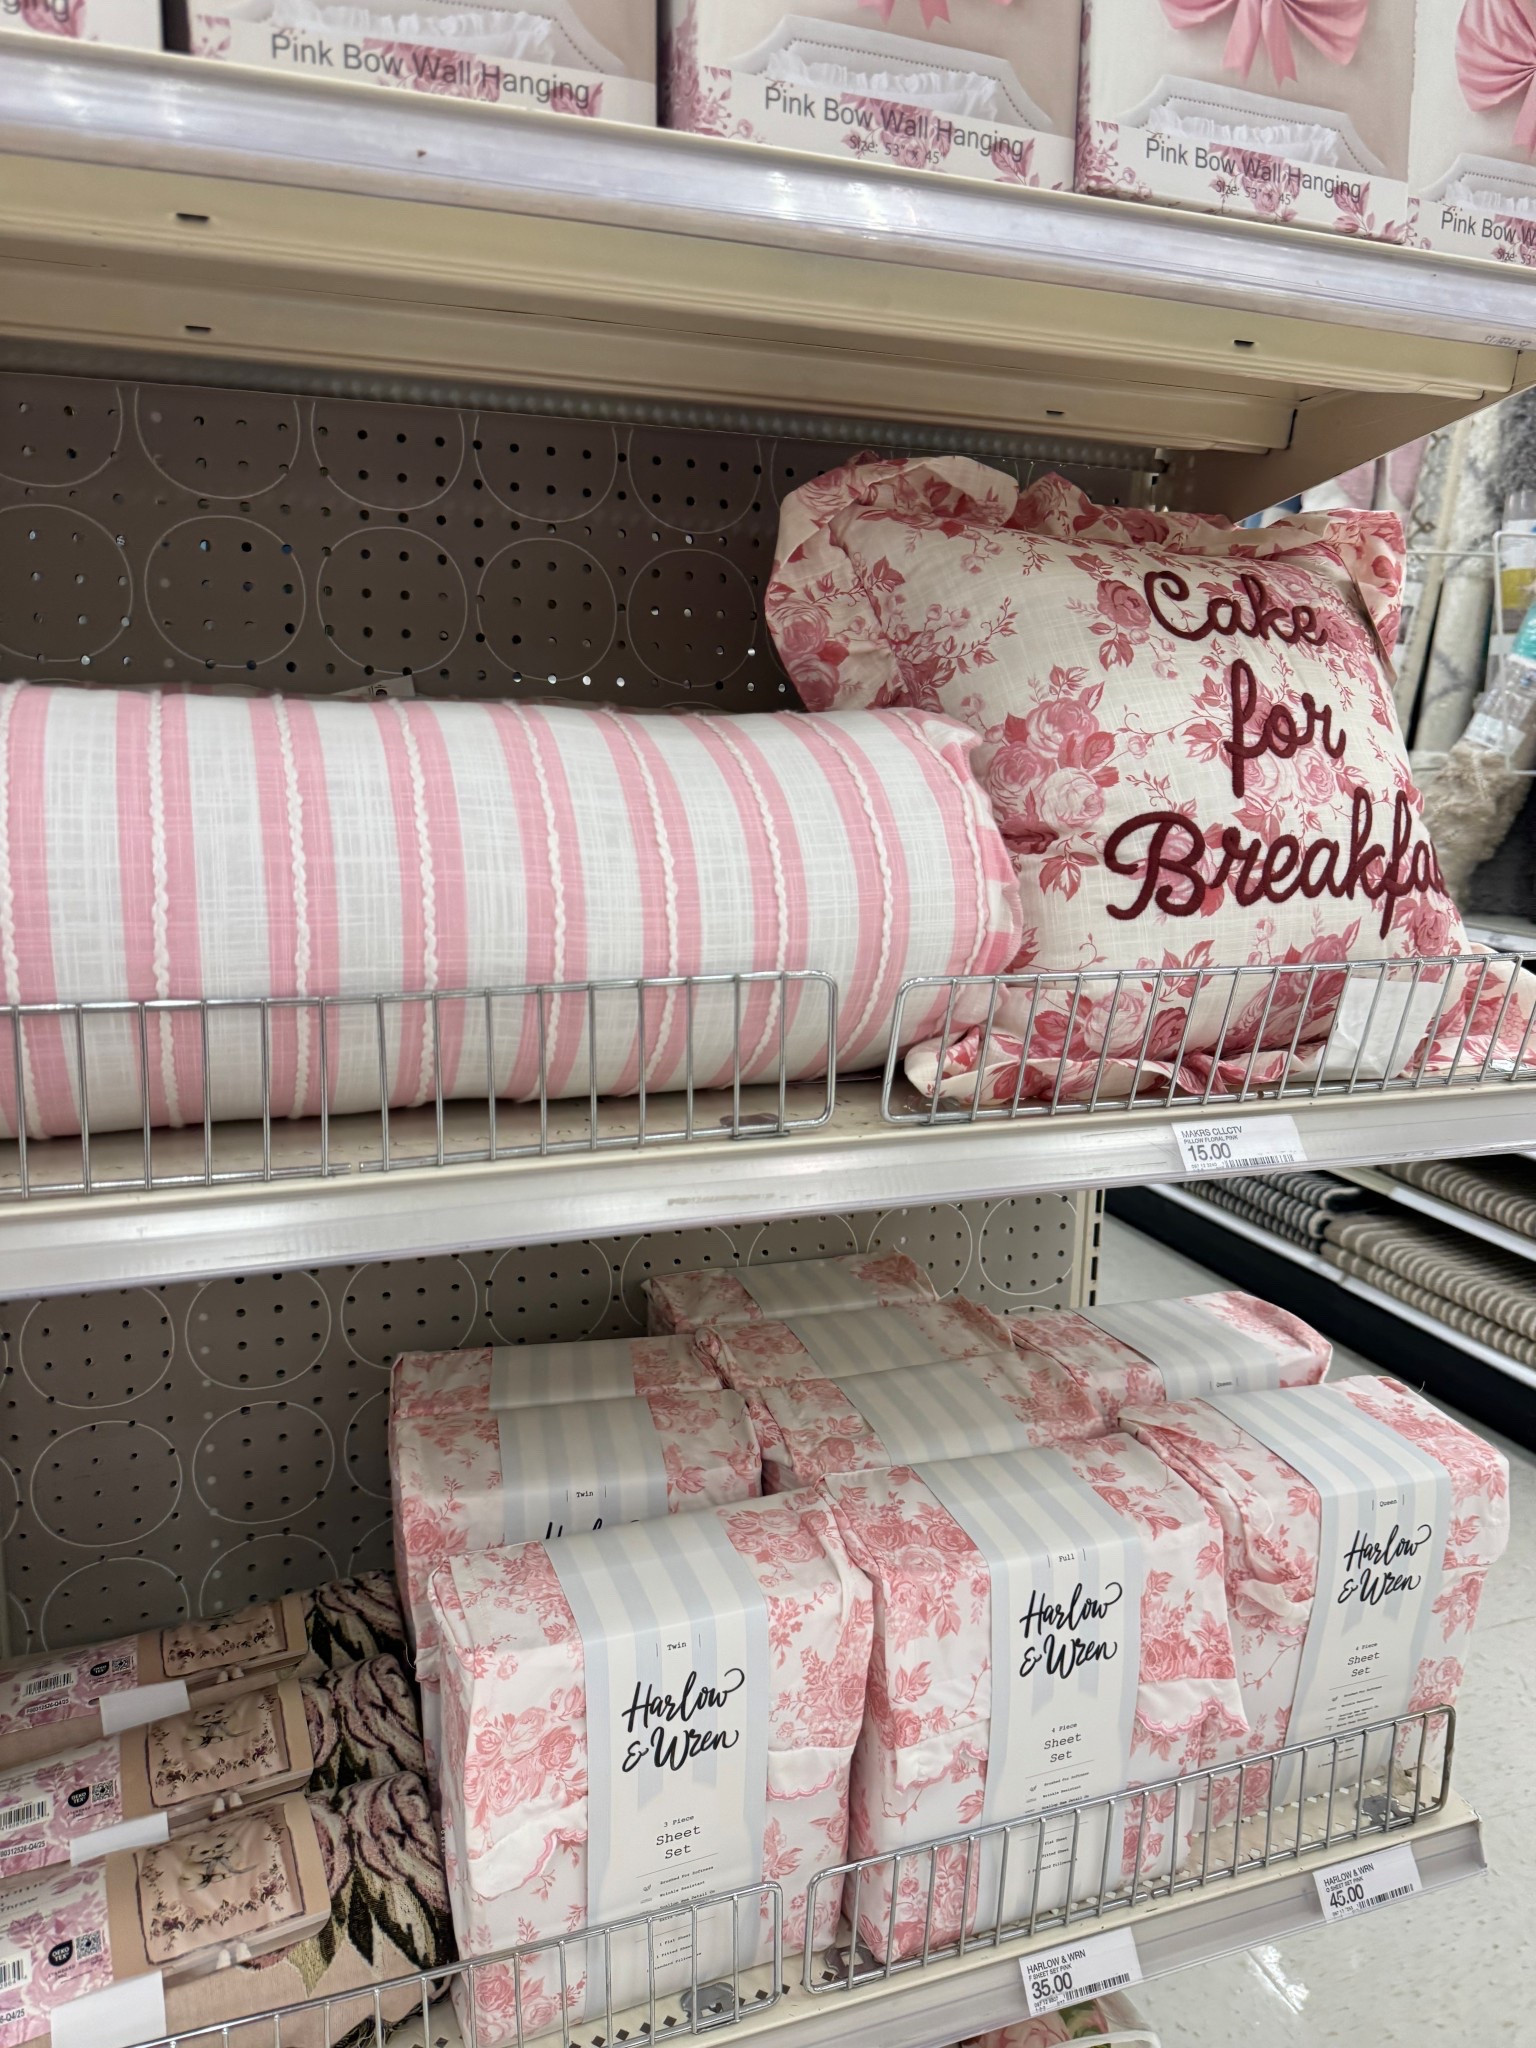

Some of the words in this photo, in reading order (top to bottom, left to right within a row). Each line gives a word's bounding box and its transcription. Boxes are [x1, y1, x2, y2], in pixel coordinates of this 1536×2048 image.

[271, 33, 334, 67] Pink
[343, 43, 404, 78] Bow
[411, 51, 471, 87] Wall
[481, 64, 590, 109] Hanging
[764, 86, 816, 119] Pink
[824, 97, 873, 128] Bow
[880, 107, 929, 140] Wall
[936, 120, 1025, 163] Hanging
[849, 134, 879, 154] Size:
[885, 142, 906, 158] 53"
[911, 150, 919, 161] x
[1146, 137, 1188, 166] Pink
[1195, 146, 1236, 174] Bow
[1241, 156, 1281, 183] Wall
[1288, 165, 1361, 203] Hanging
[1216, 179, 1240, 197] Size:
[1440, 210, 1477, 236] Pink
[1481, 218, 1517, 244] Bow
[1143, 571, 1327, 647] Cake
[1223, 658, 1347, 799] for
[1181, 1129, 1211, 1138] MAKRS
[1212, 1126, 1242, 1136] CLLCTV
[1184, 1137, 1204, 1145] PILLOW
[1205, 1135, 1225, 1143] FLORAL
[1226, 1134, 1239, 1142] PINK
[1187, 1142, 1232, 1162] 15.00
[576, 1490, 594, 1498] Twin
[1380, 1499, 1398, 1508] Queen
[1058, 1553, 1075, 1562] Full
[1344, 1524, 1432, 1572] Harlow
[1337, 1578, 1359, 1605] &
[1360, 1567, 1422, 1606] Wren
[1019, 1581, 1123, 1639] Harlow
[666, 1641, 688, 1651] Twin
[1019, 1646, 1043, 1678] &
[1043, 1633, 1118, 1679] Wren
[1347, 1651, 1380, 1666] Sheet
[1351, 1666, 1371, 1678] Set
[621, 1667, 745, 1733] Harlow
[1058, 1722, 1078, 1732] Piece
[621, 1740, 649, 1773] &
[650, 1726, 740, 1772] Wren
[1043, 1732, 1082, 1750] Sheet
[1049, 1749, 1073, 1763] Set
[672, 1814, 695, 1826] Piece
[656, 1825, 701, 1846] Sheet
[664, 1844, 692, 1860] Set
[1324, 1870, 1353, 1888] HARLOW
[1353, 1869, 1359, 1877] &
[1359, 1862, 1375, 1874] WRN
[1330, 1883, 1365, 1909] 45.00
[52, 1946, 70, 1956] OEKO
[1027, 1956, 1060, 1975] HARLOW
[1061, 1955, 1068, 1964] &
[1068, 1949, 1086, 1962] WRN
[1033, 1969, 1049, 1980] SHEET
[1049, 1966, 1059, 1975] SET
[1059, 1963, 1073, 1973] PINK
[1031, 1971, 1073, 2000] 35.00
